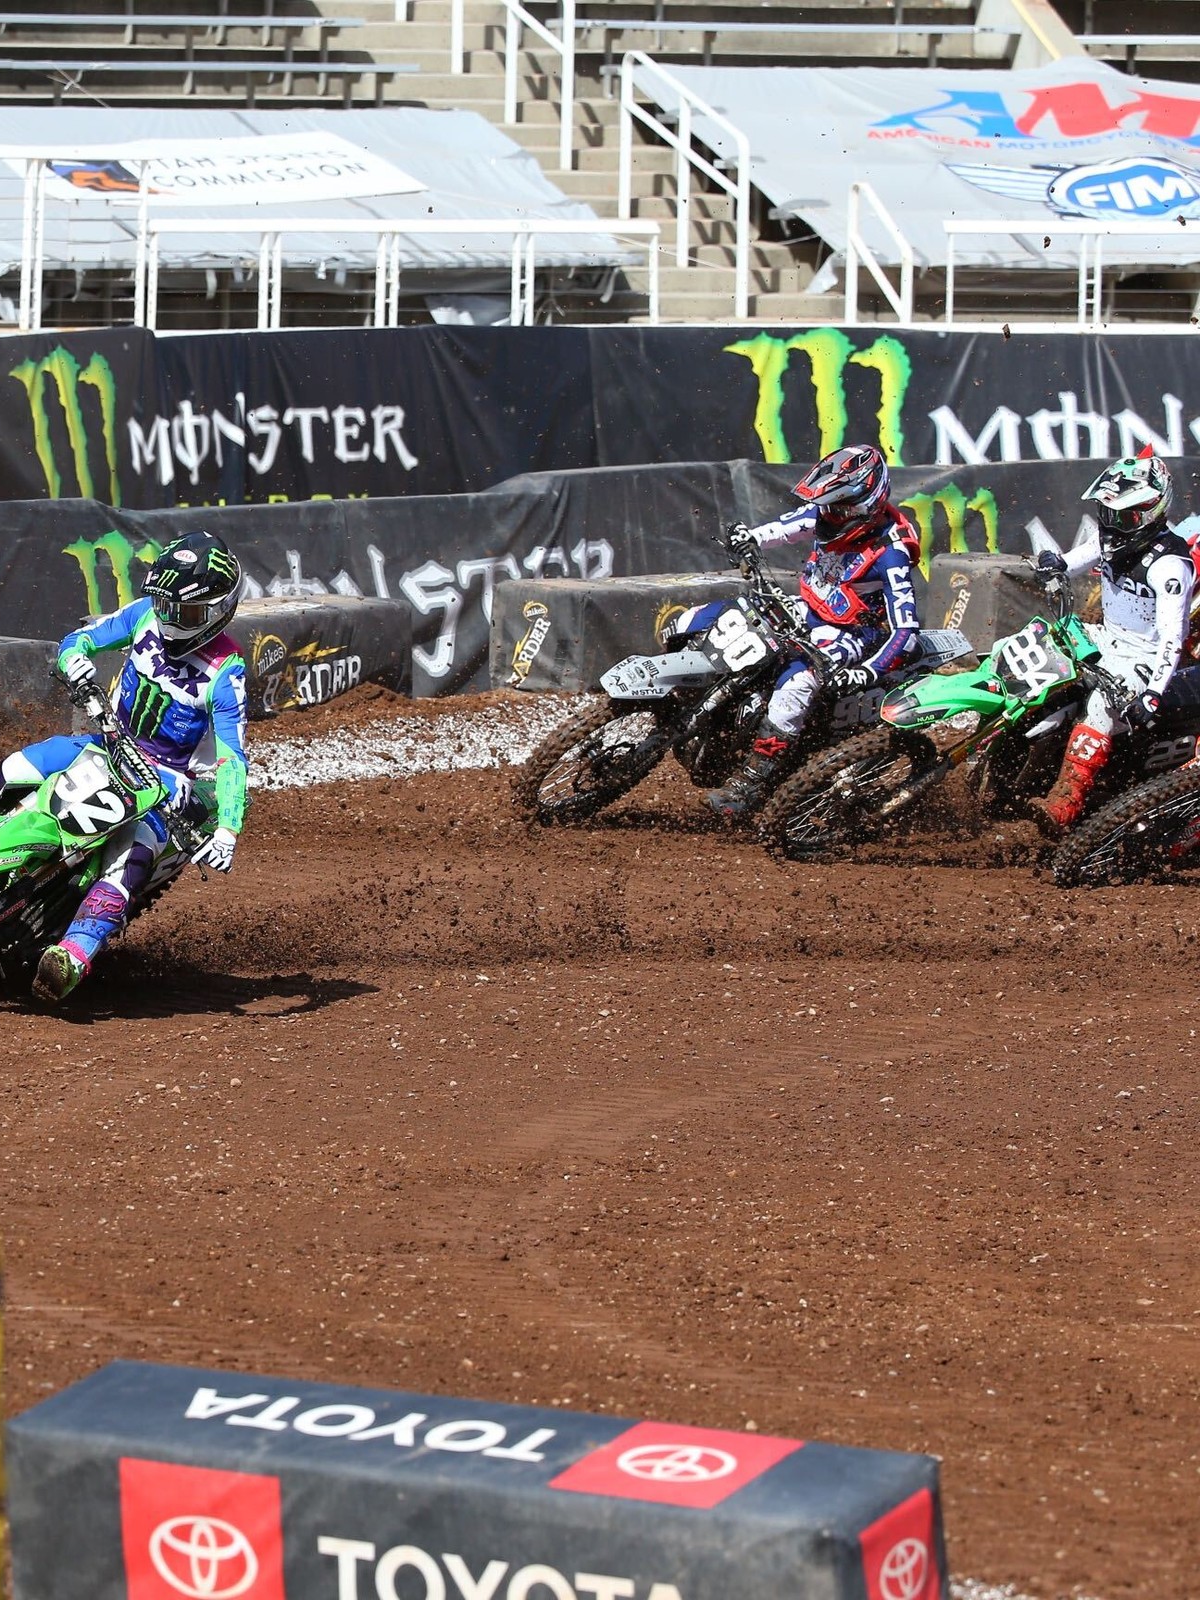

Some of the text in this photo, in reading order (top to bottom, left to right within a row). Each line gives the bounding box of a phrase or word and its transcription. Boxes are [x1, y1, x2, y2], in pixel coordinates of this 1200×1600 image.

[867, 83, 1200, 146] AM
[153, 162, 369, 188] COMMISSION
[1073, 174, 1198, 210] FIM
[127, 391, 418, 486] MONSTER
[928, 390, 1200, 465] MON
[887, 566, 920, 629] FXR
[257, 644, 284, 677] mike's
[708, 607, 767, 673] 90
[1154, 641, 1173, 682] seven
[834, 668, 867, 687] FXR
[184, 1387, 558, 1463] TOYOTA
[316, 1535, 685, 1600] TOYO
